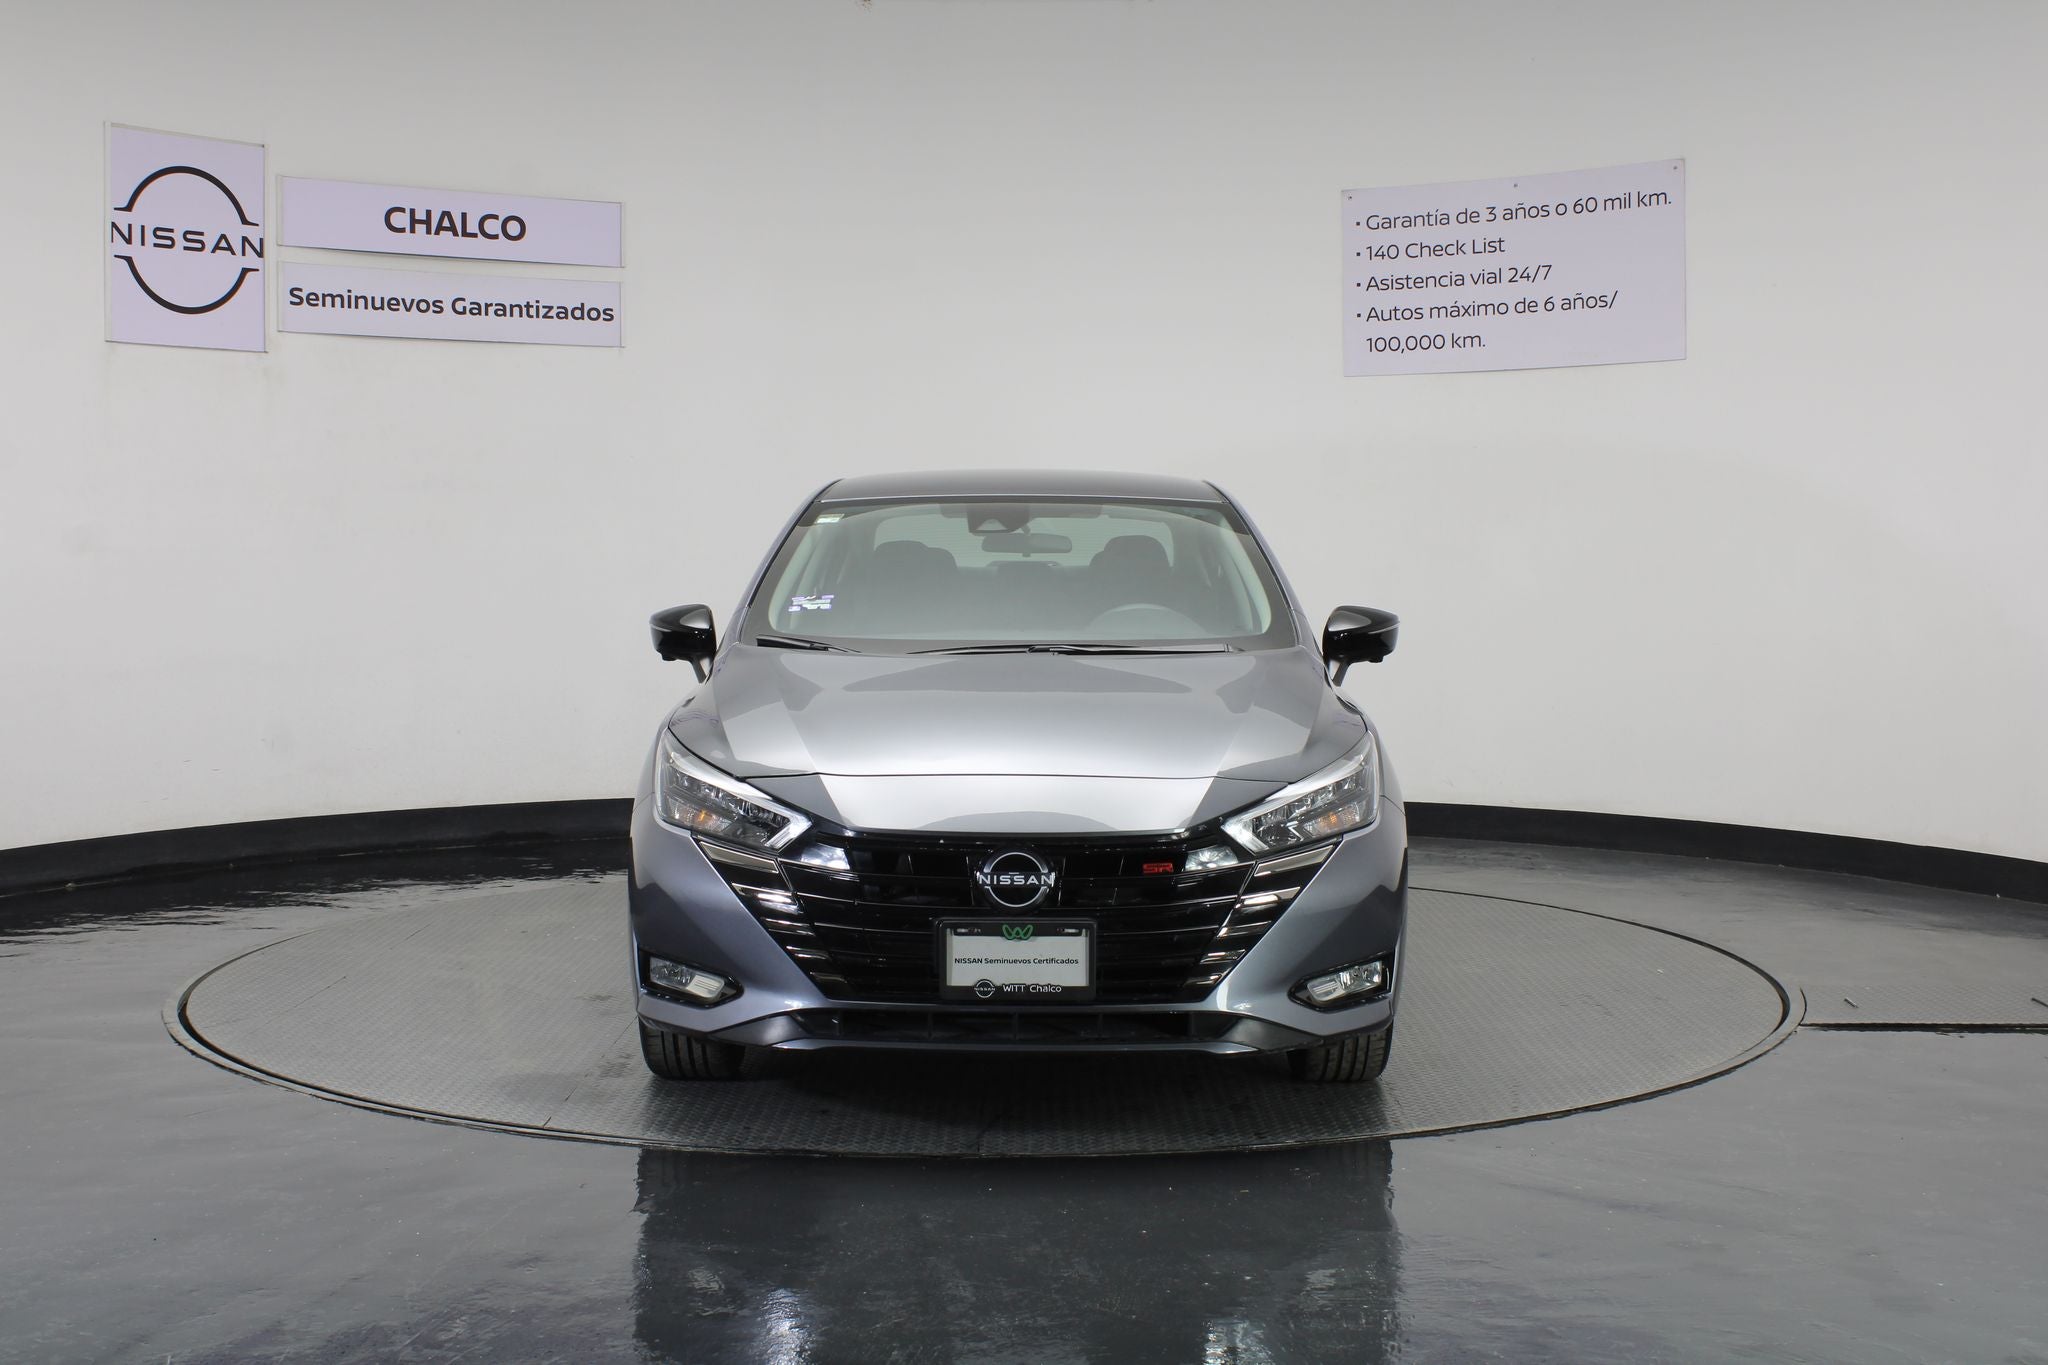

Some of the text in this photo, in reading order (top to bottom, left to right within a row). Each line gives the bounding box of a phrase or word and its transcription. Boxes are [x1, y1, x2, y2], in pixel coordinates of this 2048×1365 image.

[1365, 190, 1672, 231] Garantía de 3 años o 60 mil km.
[383, 206, 527, 242] CHALCO
[111, 221, 264, 259] NISSAN
[1365, 237, 1506, 261] 140 Check List
[1365, 264, 1553, 292] Asistencia vial 24/7
[289, 286, 615, 322] Seminuevos Garantizados
[1365, 290, 1619, 323] Autos máximo de 6 años/
[1366, 332, 1486, 354] 100,000 km.
[979, 874, 1053, 885] NISSAN
[1142, 862, 1174, 874] SR
[954, 957, 1079, 965] NISSAN Seminuevos Certificados
[1002, 983, 1062, 993] WITT Chalco
